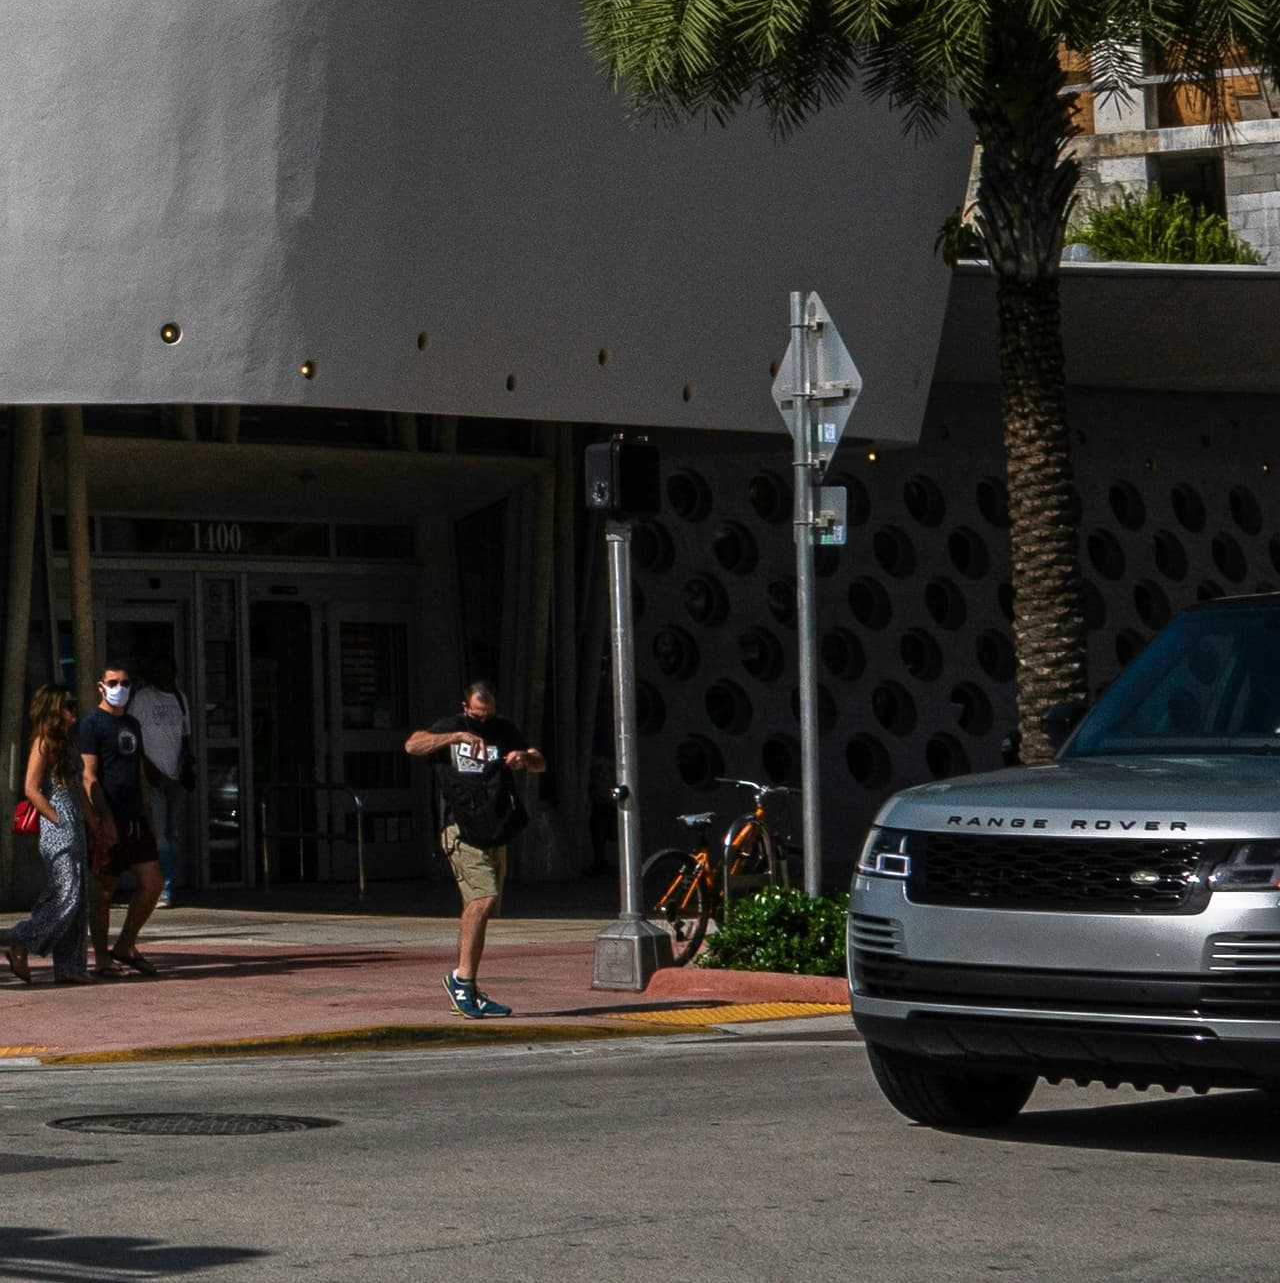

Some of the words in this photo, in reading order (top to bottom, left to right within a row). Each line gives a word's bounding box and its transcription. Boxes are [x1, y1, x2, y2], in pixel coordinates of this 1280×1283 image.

[192, 523, 242, 552] 1400
[947, 815, 1049, 830] RANGE
[1071, 818, 1188, 832] ROVER
[454, 989, 467, 1000] N
